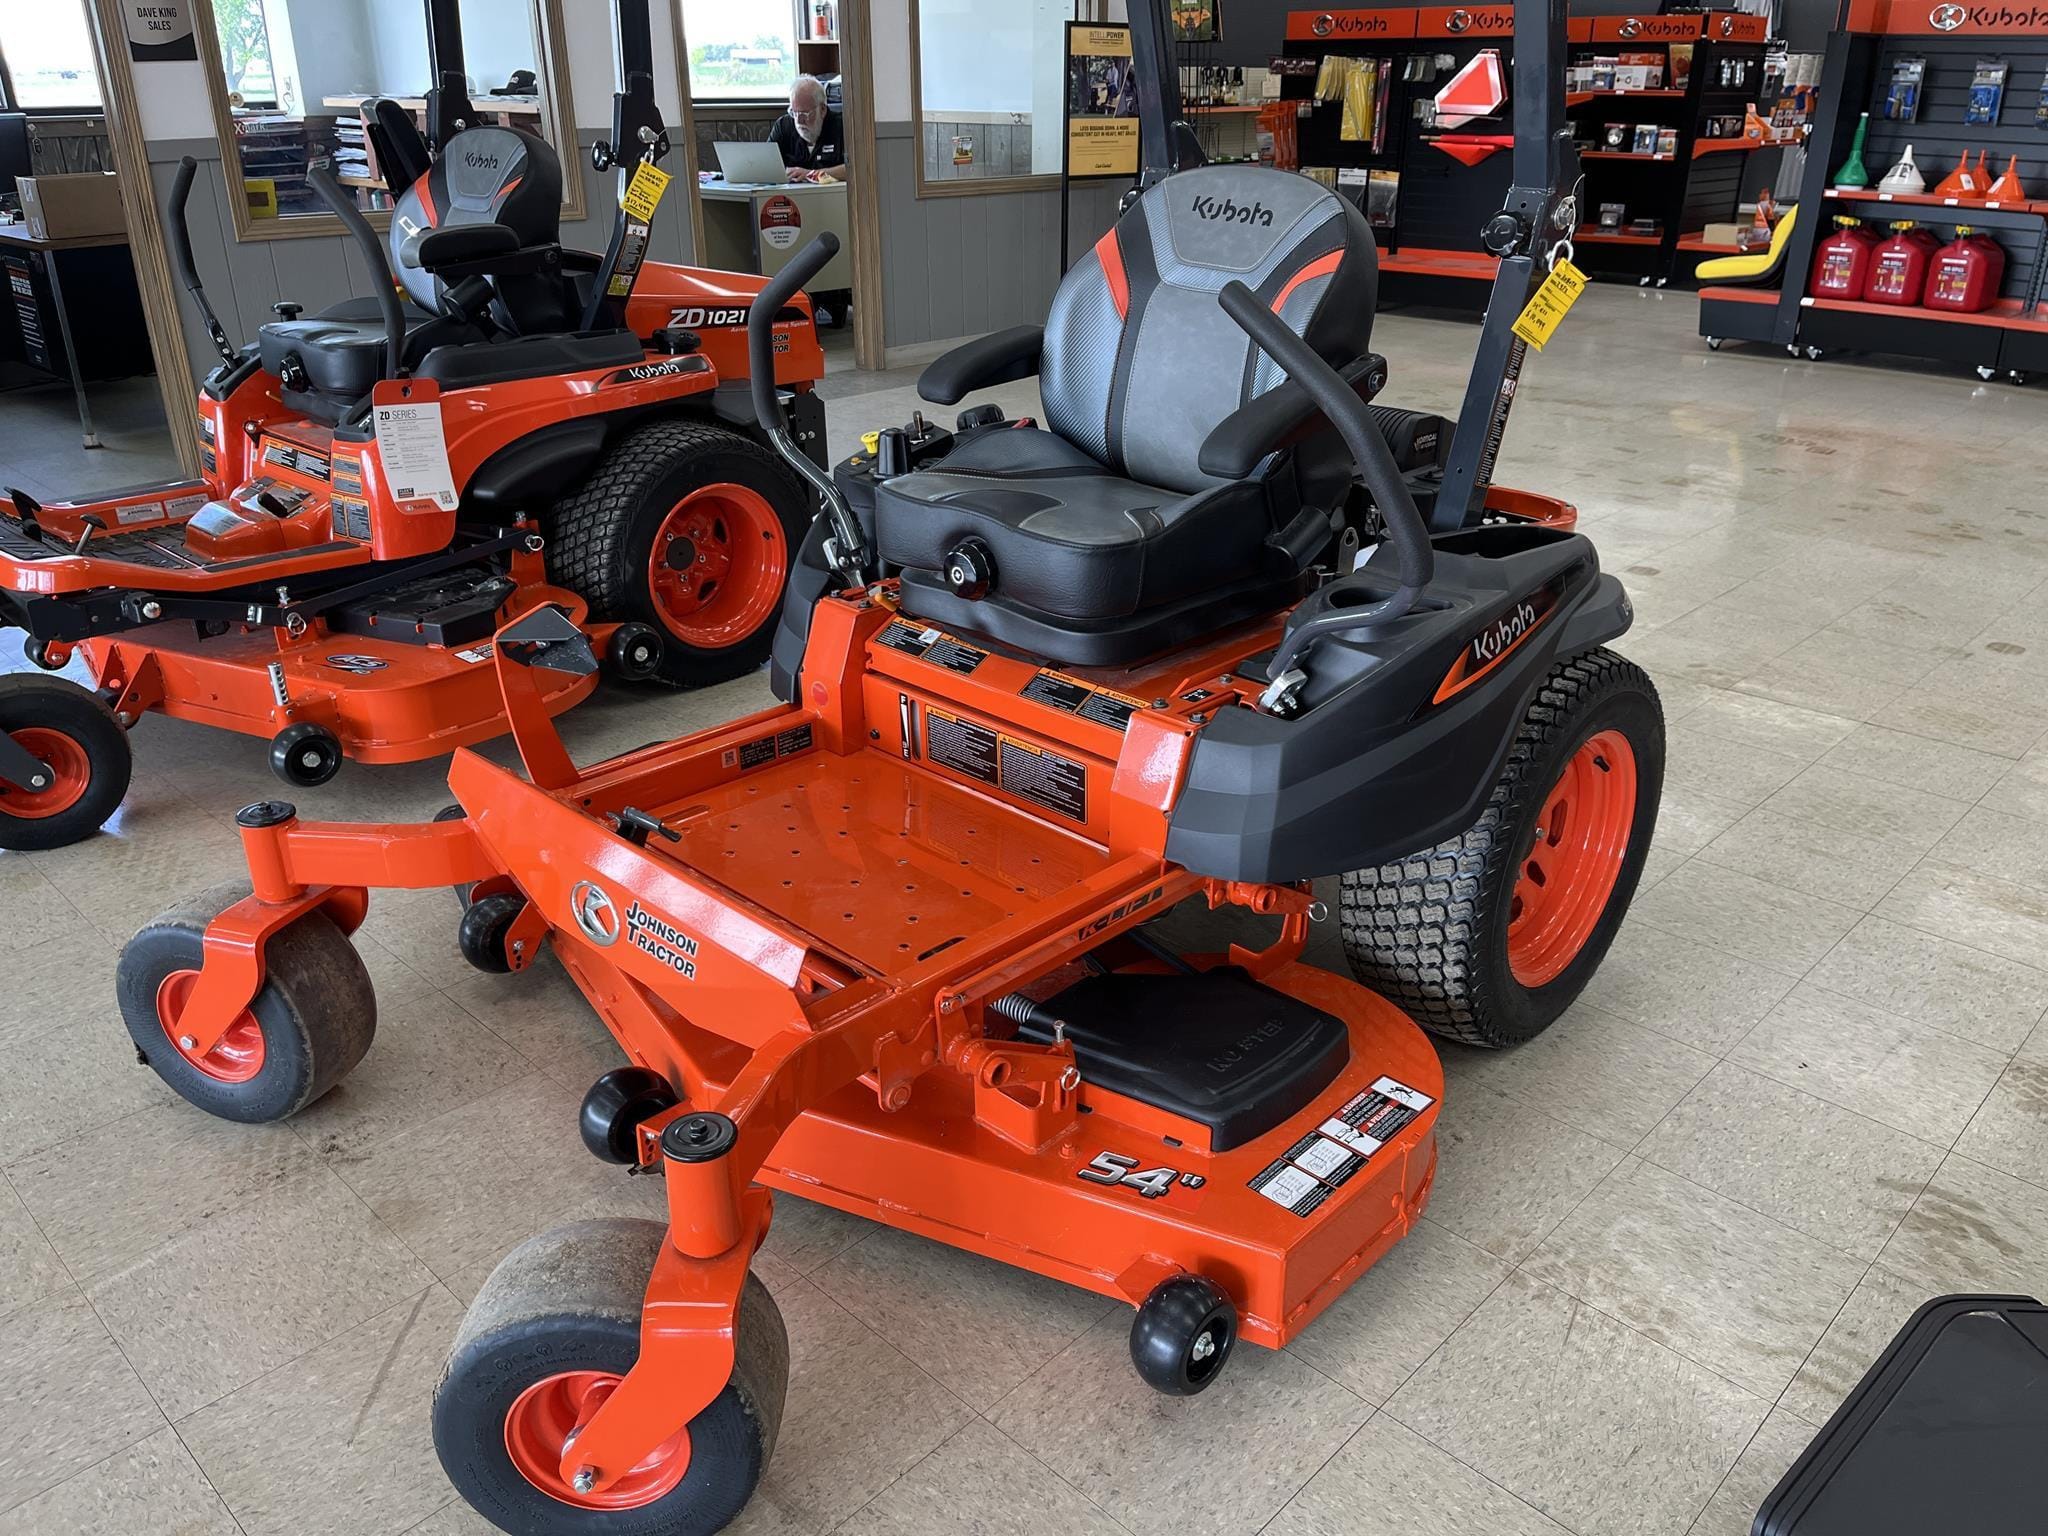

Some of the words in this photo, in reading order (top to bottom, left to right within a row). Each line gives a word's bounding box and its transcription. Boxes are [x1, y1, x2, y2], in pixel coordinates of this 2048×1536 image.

[137, 8, 158, 18] DAVE
[160, 8, 177, 18] KING
[148, 21, 171, 30] SALES
[1335, 16, 1387, 32] Kubota
[1473, 13, 1514, 31] Kubo
[1643, 22, 1695, 35] Kubota
[465, 152, 498, 169] Kubota
[1192, 196, 1274, 226] Kubota
[629, 362, 680, 379] Kubota
[380, 411, 390, 420] ZD
[392, 409, 417, 419] SERIES
[1474, 604, 1535, 660] Kubota
[1052, 672, 1074, 682] WARNING
[901, 695, 906, 704] F
[1111, 692, 1146, 707] ADVERTENCIA
[904, 748, 908, 758] E
[626, 901, 698, 956] JOHNSON
[626, 921, 696, 978] TRACTOR
[1346, 1092, 1368, 1110] DANGER
[1372, 1105, 1393, 1124] PELIGRO
[1077, 1150, 1206, 1198] 54"
